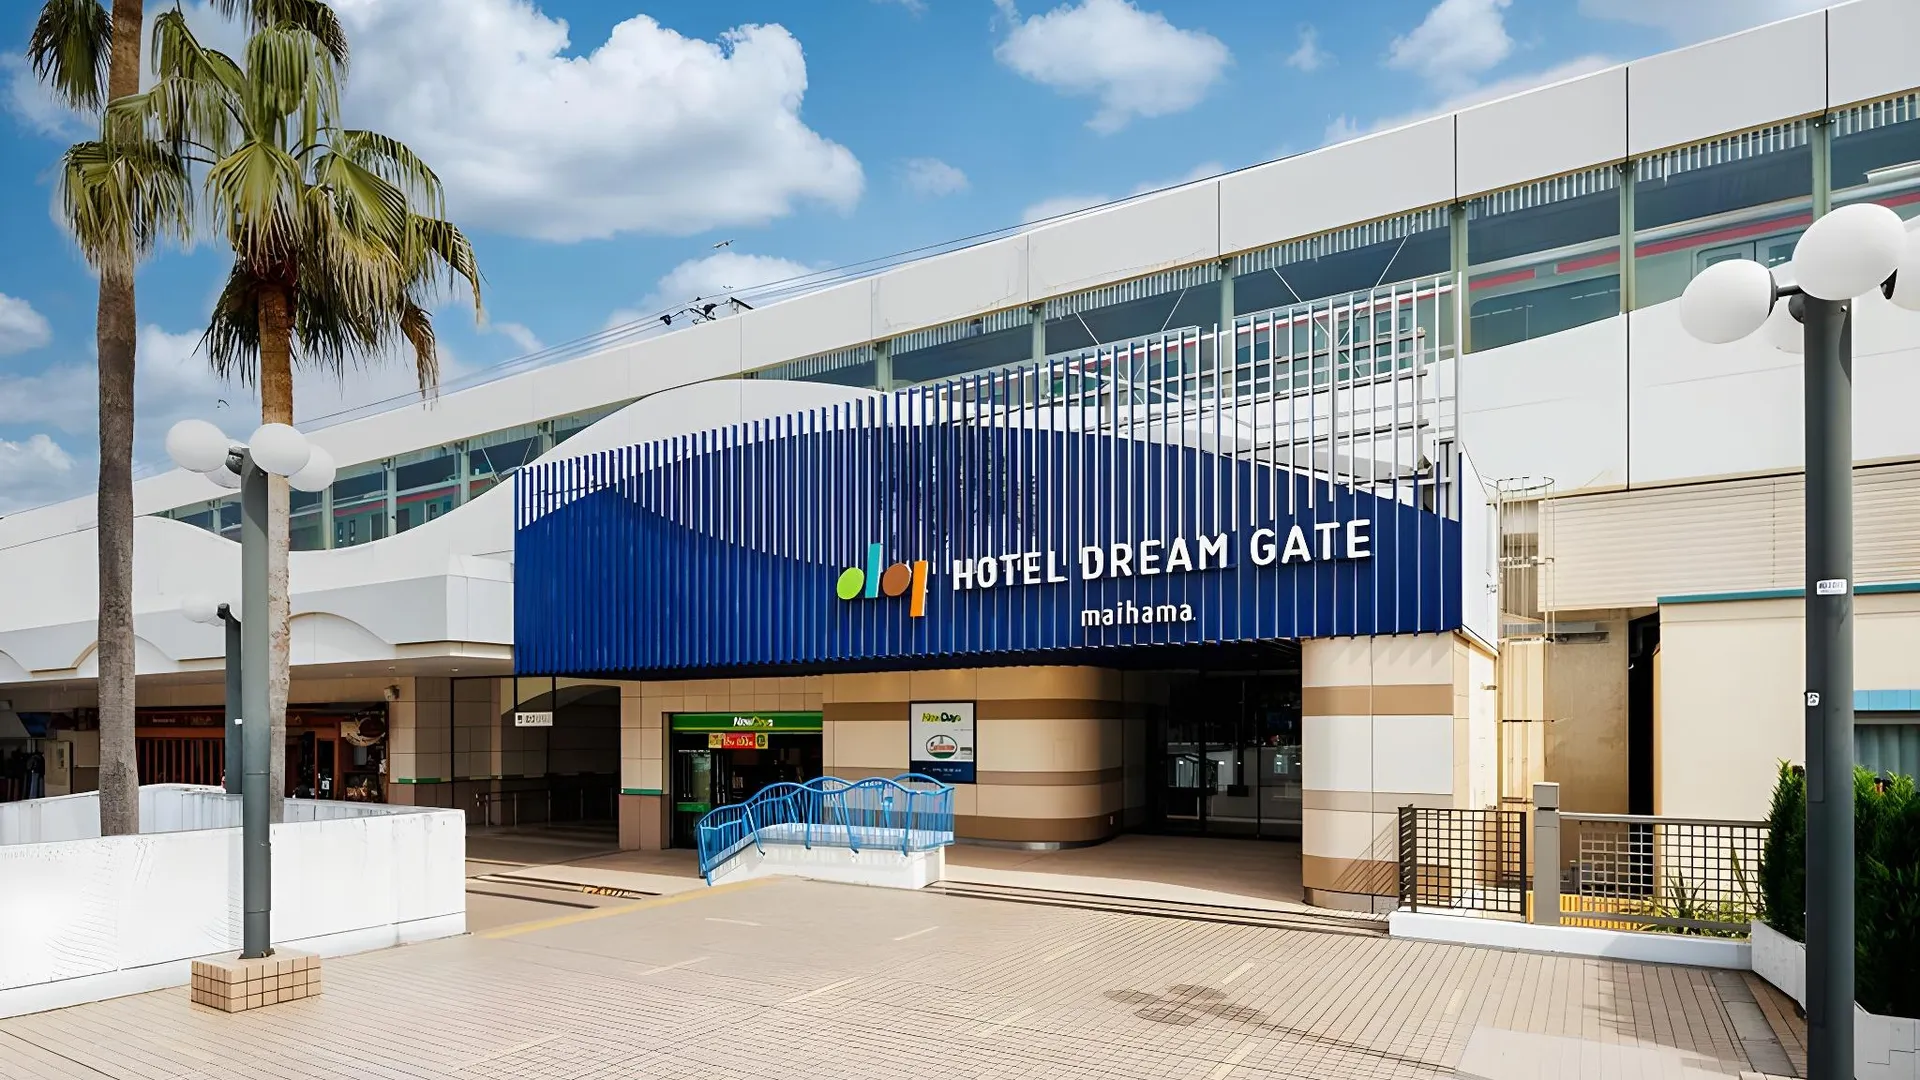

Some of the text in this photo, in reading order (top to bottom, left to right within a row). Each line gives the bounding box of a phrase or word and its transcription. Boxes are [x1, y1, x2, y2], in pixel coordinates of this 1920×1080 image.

[953, 519, 1371, 591] HOTEL DREAM GATE
